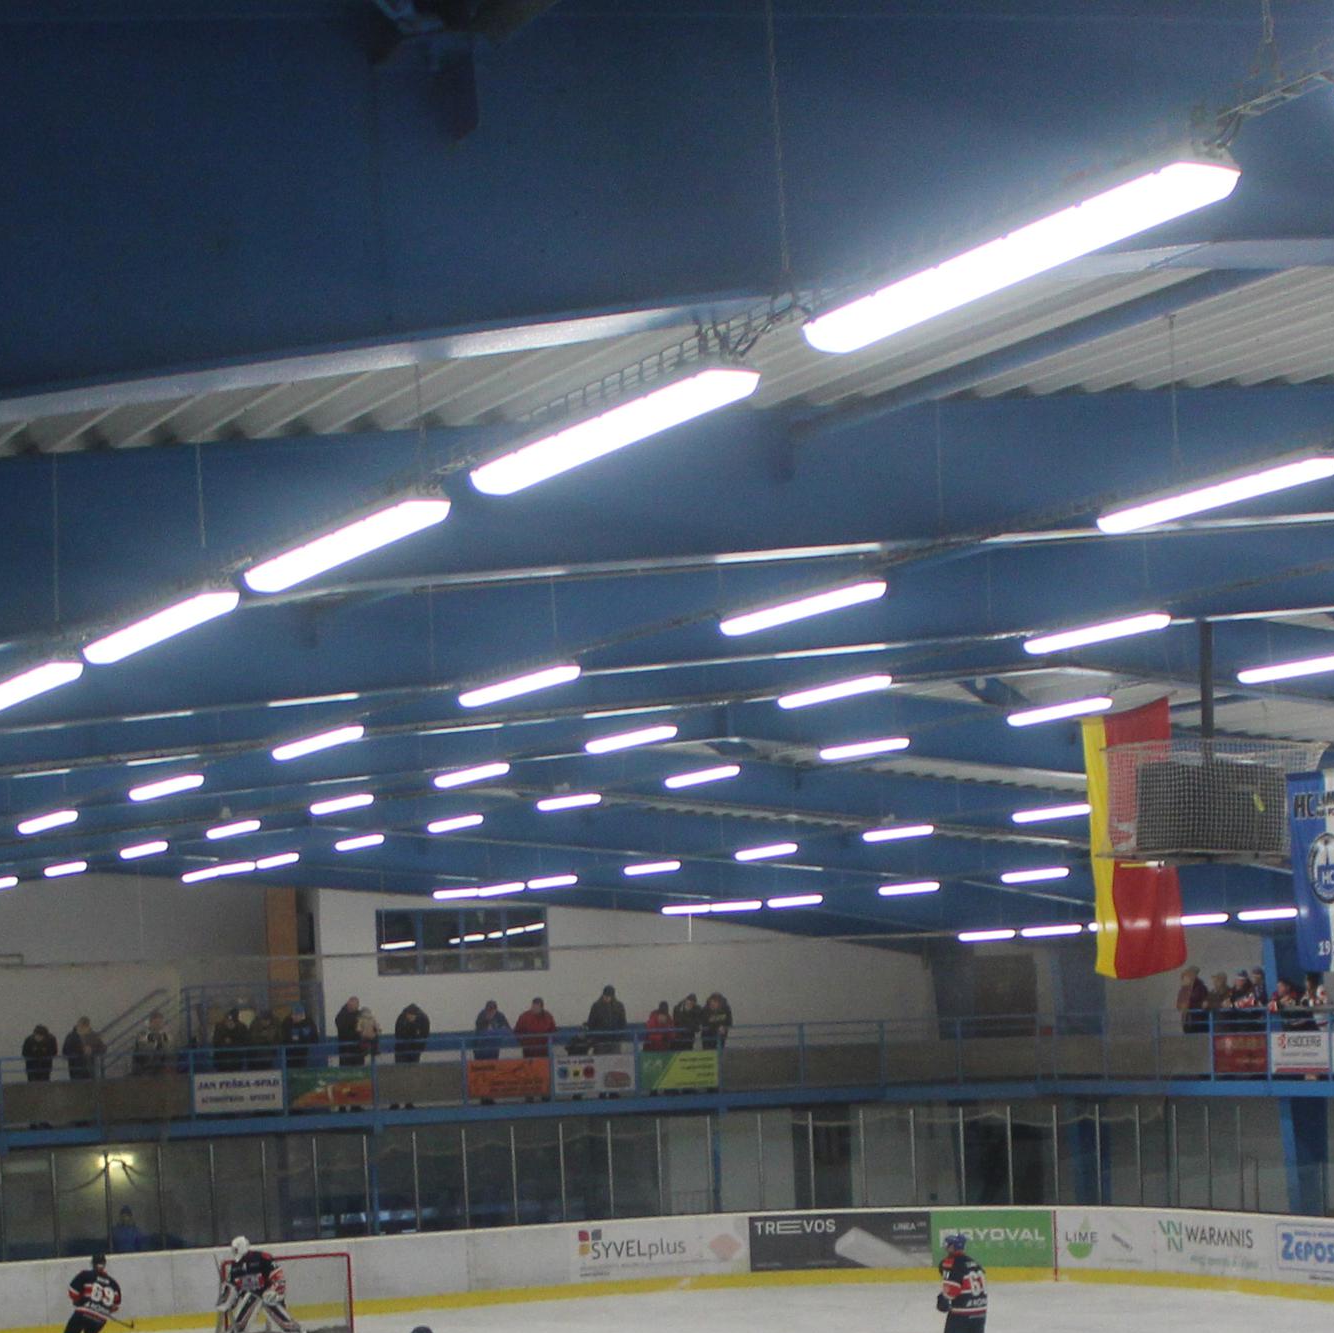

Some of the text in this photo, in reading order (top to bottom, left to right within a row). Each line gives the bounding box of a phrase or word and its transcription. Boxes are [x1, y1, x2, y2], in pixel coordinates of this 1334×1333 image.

[1294, 793, 1317, 818] HC
[755, 1218, 836, 1235] TREVOS
[1066, 1231, 1099, 1244] LIME
[1186, 1226, 1254, 1250] WARMNIS
[591, 1238, 687, 1261] SYVELplus
[91, 1282, 116, 1307] 69
